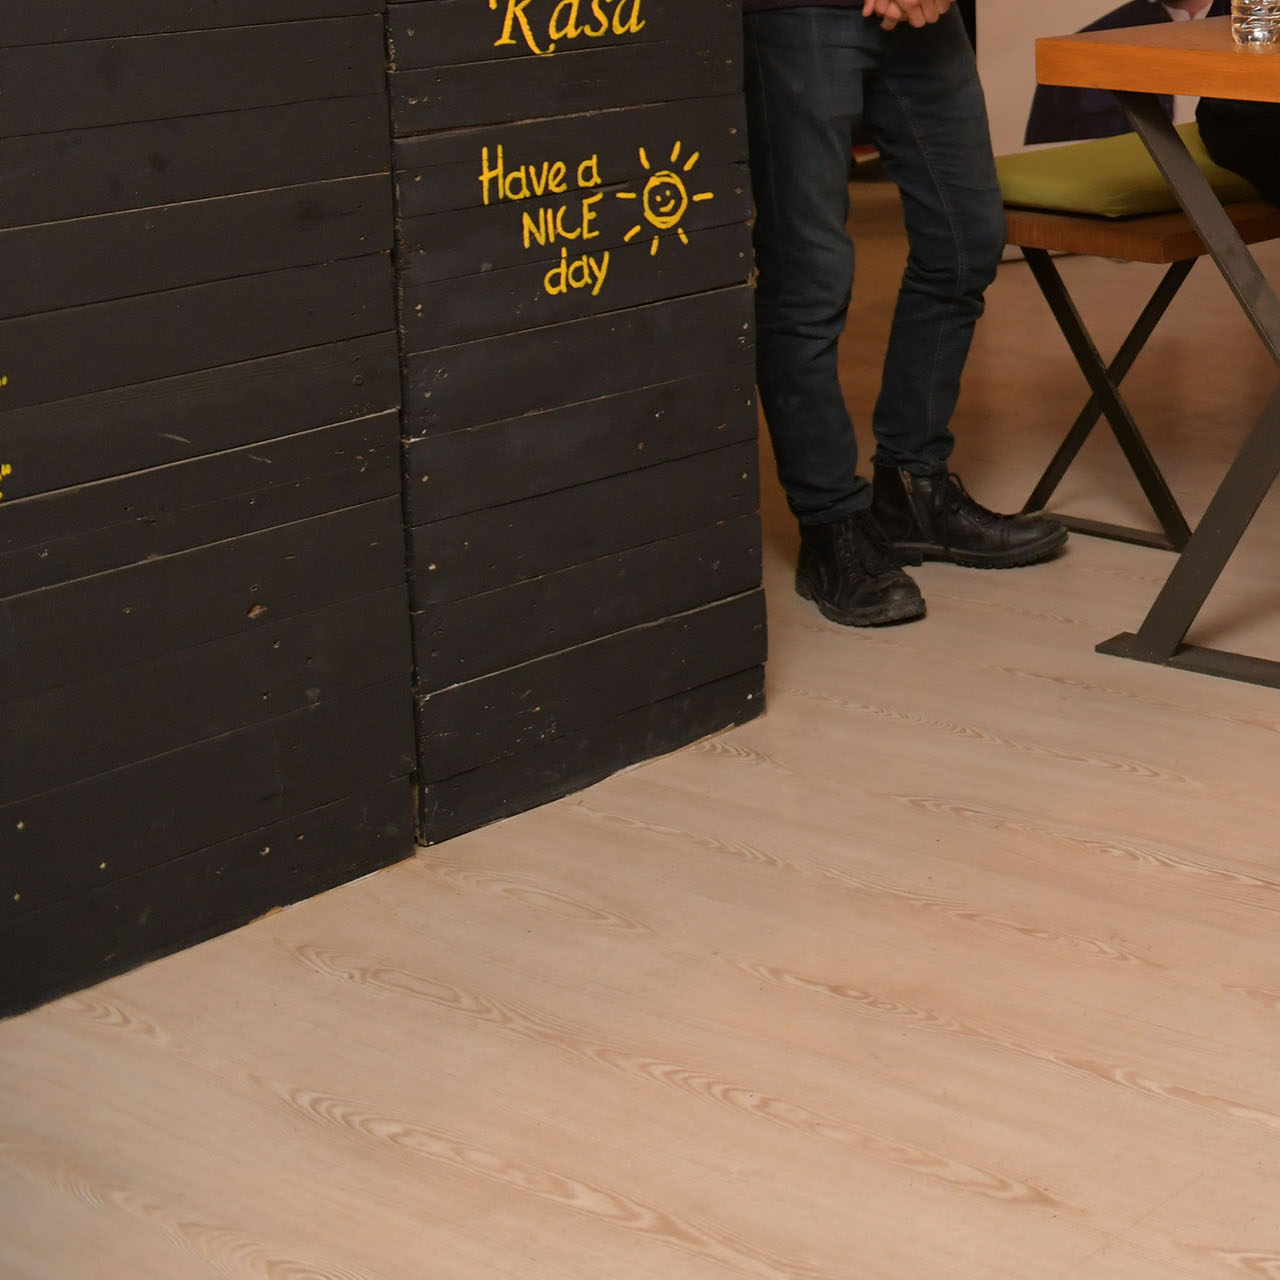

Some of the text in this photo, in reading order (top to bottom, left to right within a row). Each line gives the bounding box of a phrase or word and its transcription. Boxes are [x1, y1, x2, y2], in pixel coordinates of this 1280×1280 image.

[478, 144, 602, 206] Have a
[521, 191, 604, 249] NICE
[543, 246, 610, 296] day
